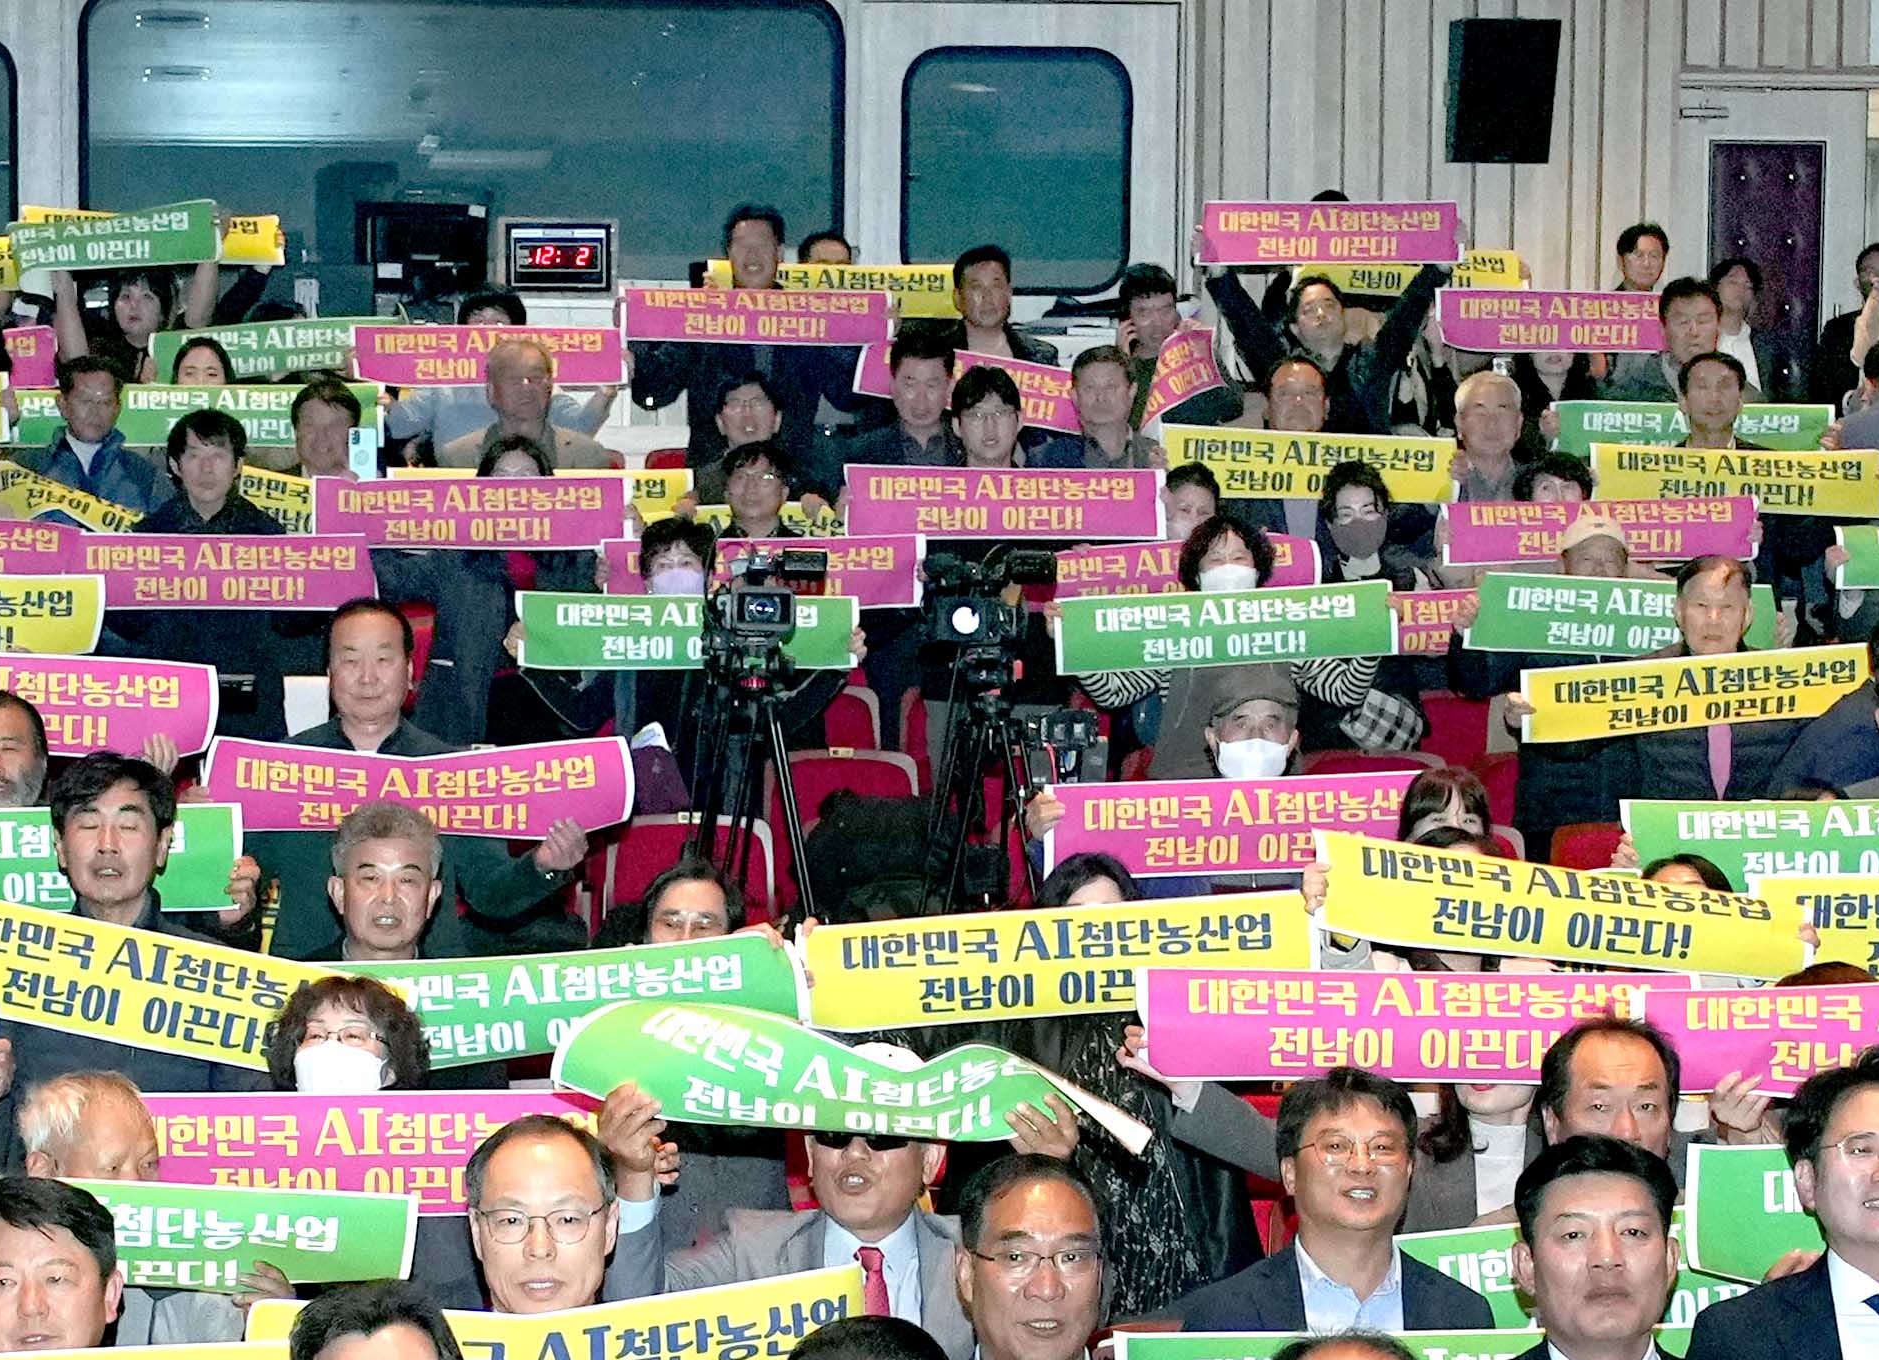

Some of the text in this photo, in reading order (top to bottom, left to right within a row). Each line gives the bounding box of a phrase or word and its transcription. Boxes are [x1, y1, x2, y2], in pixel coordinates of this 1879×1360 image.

[1218, 208, 1441, 233] 대한민국 AI첨단농산업
[86, 239, 150, 261] 이끈다!
[575, 246, 590, 266] 2
[1257, 236, 1397, 258] 전남이 이끈다!
[1459, 297, 1541, 320] 대한민국
[684, 313, 826, 338] 전남이 이끈다!
[1498, 323, 1559, 345] 전남이
[1183, 438, 1275, 465] 대한민국
[1617, 451, 1862, 482] 대한민국 AI첨단농산업
[869, 474, 1135, 501] 대한민국 AI첨단농산업
[1224, 469, 1293, 493] 전남이
[337, 484, 602, 514] 대한민국 AI첨단농산업
[470, 517, 551, 542] 이끈다!
[1002, 505, 1083, 530] 이끈다!
[86, 542, 356, 571] 대한민국 AI첨단농산업
[134, 575, 305, 601] 전남이 이끈다!
[1507, 586, 1599, 615] 대한민국
[556, 603, 653, 627] 대한민국
[1095, 593, 1356, 633] 대한민국 AI첨단농산업
[1143, 629, 1306, 662] 전남이 이끈다!
[1554, 658, 1856, 704] 대한민국 AI첨단농산업
[1607, 694, 1796, 731] 전남이 이끈다!
[235, 754, 596, 799] 대한민국 AI첨단농산업
[1084, 795, 1213, 831] 대한민국
[1361, 846, 1772, 921] 대한민국 AI첨단농산업
[842, 912, 1272, 970] 대한민국 AI첨단농산업
[1432, 897, 1692, 960] 전남이 이끈다!
[503, 953, 743, 1006] AI첨단농산업
[919, 973, 1034, 1014] 전남이
[1, 967, 121, 1026] 전남이
[1188, 978, 1358, 1017] 대한민국
[1686, 995, 1864, 1032] 대한민국
[1268, 1027, 1394, 1068] 전남이
